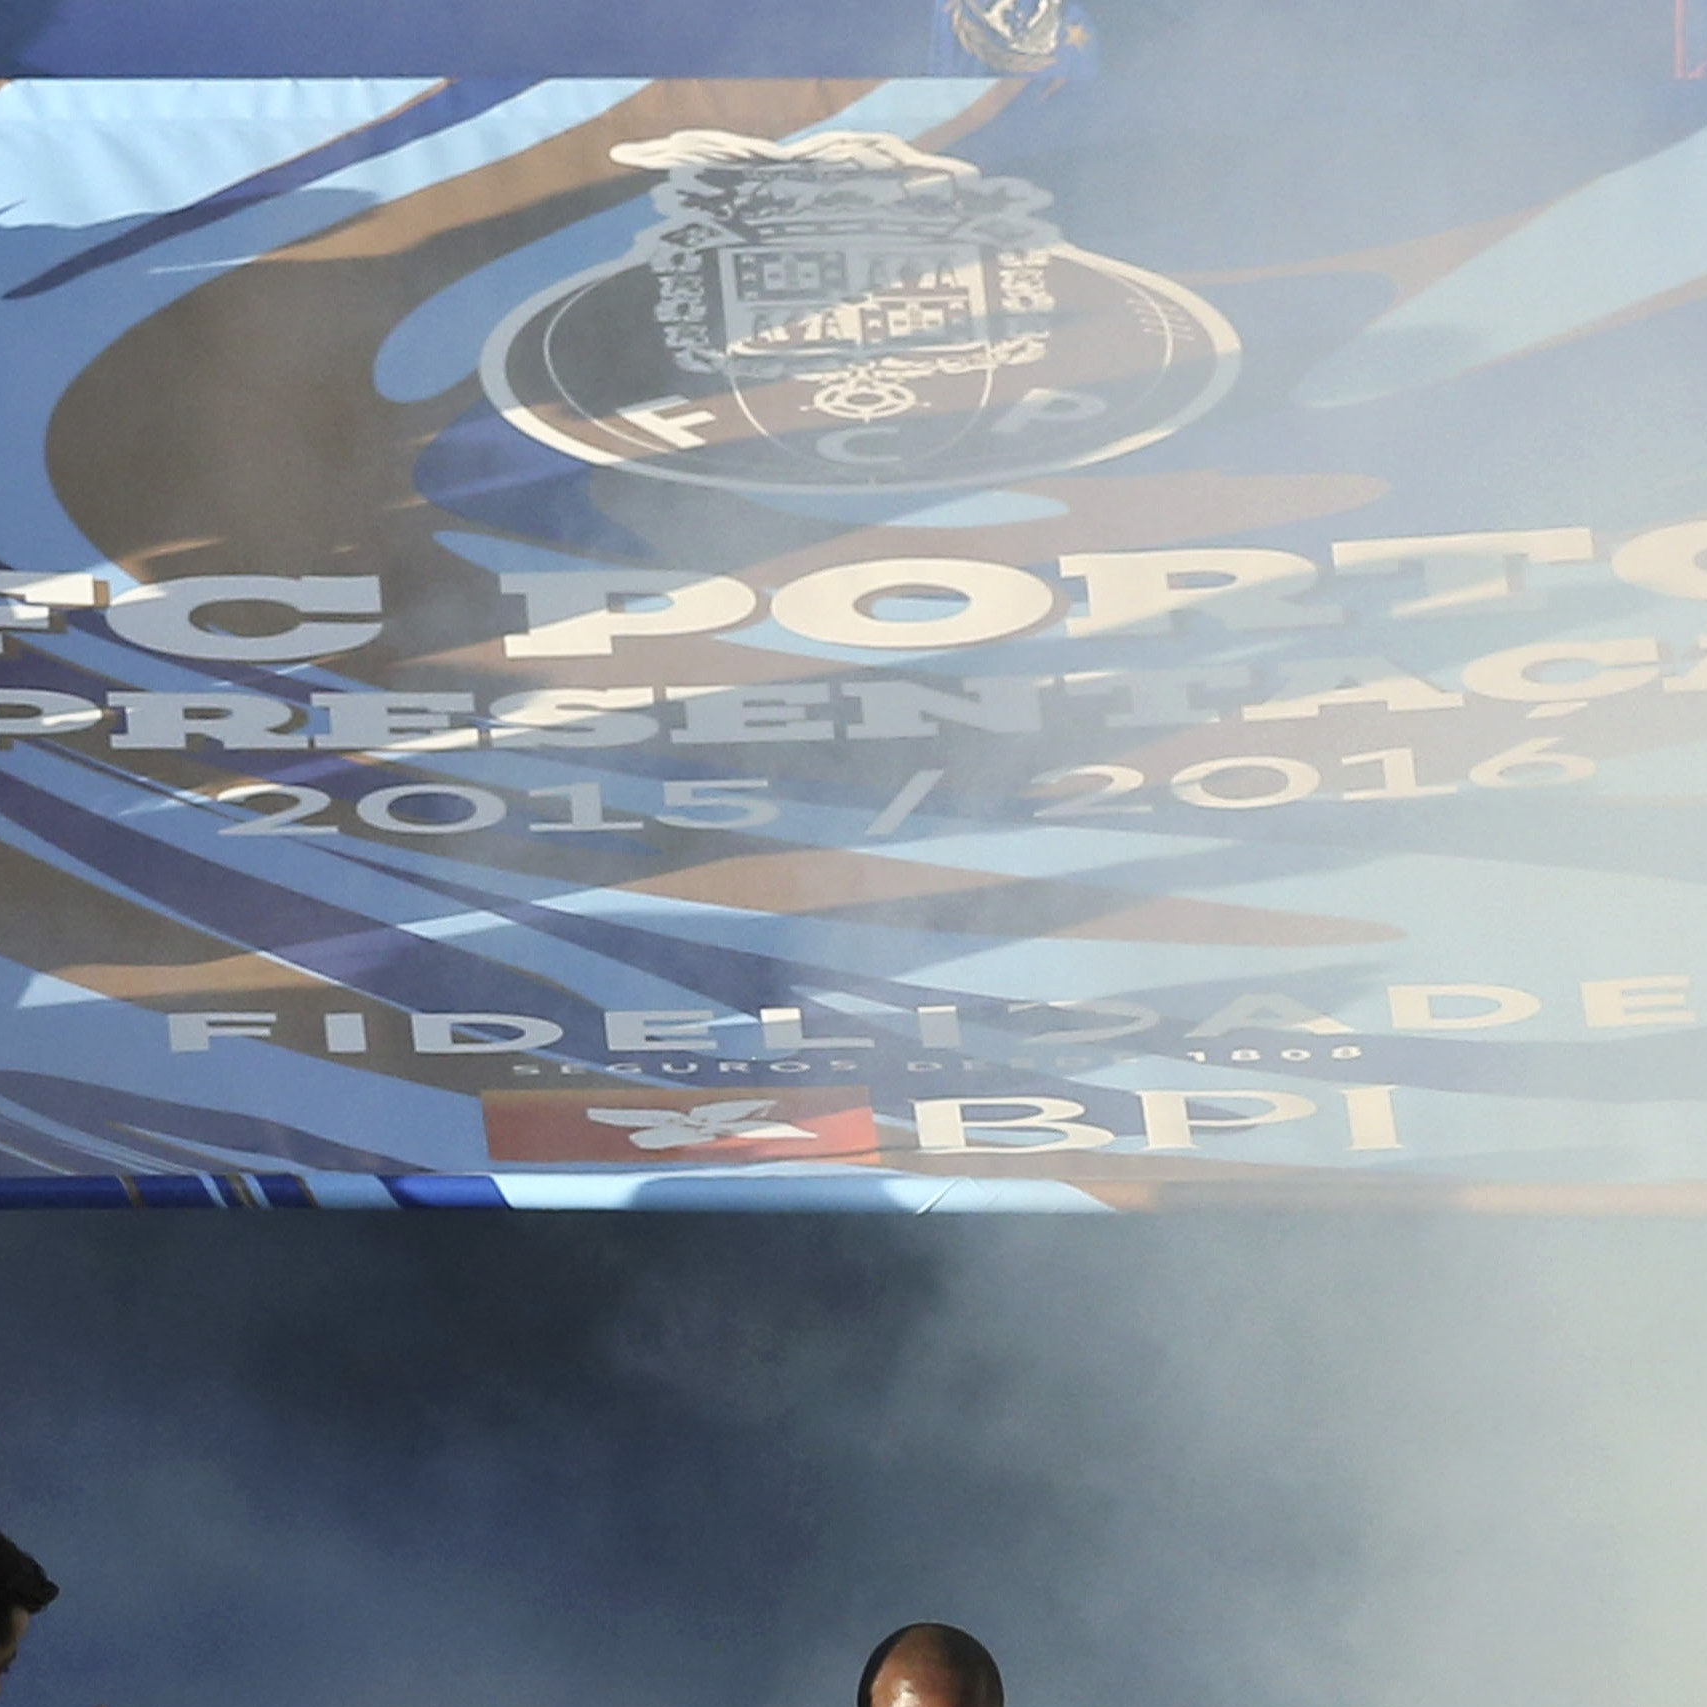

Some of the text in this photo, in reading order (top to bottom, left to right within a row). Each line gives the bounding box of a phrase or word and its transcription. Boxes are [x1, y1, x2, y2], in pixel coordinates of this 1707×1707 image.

[217, 776, 780, 838] 2015
[1033, 736, 1598, 821] 2016
[167, 975, 1698, 1054] FIDELIDADE
[511, 1059, 859, 1076] SEGUROS
[912, 1083, 1402, 1154] BPI
